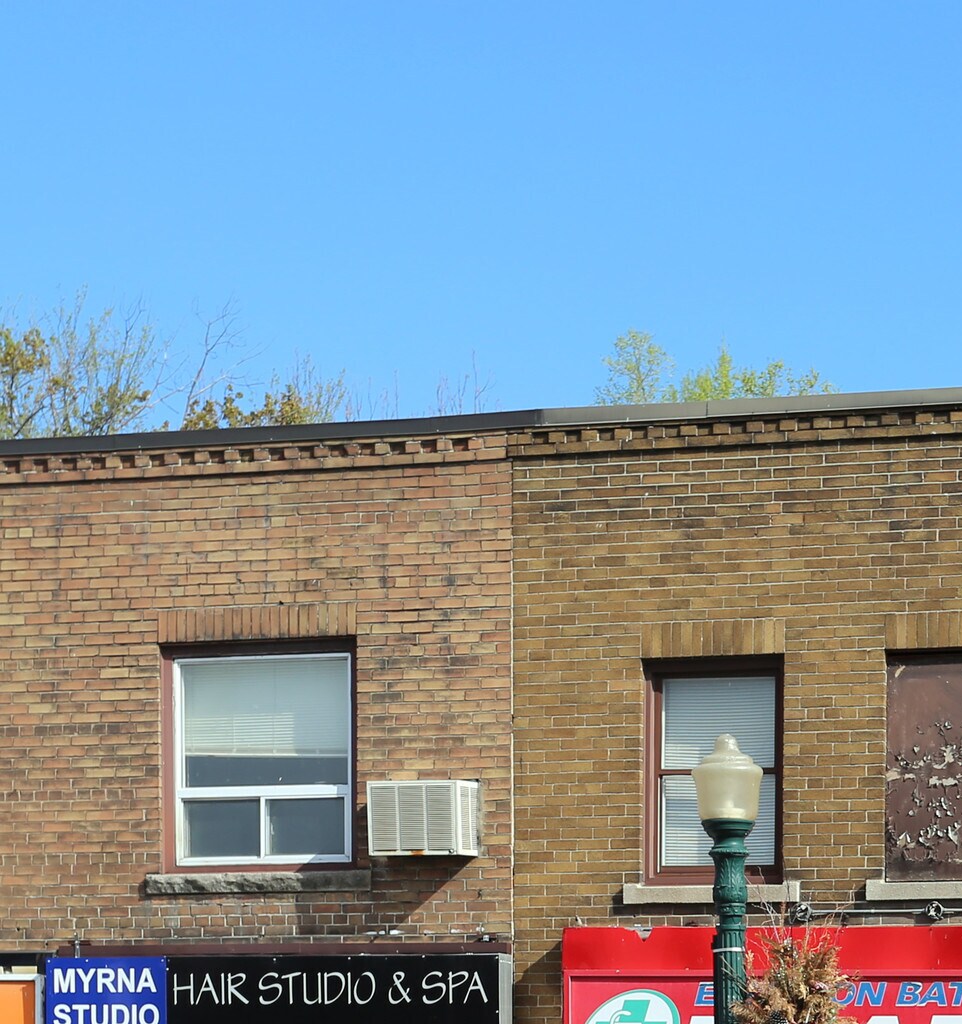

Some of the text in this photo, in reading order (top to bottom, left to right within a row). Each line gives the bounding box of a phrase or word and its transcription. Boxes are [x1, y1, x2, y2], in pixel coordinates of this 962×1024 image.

[53, 968, 157, 994] MYRNA
[173, 970, 489, 1005] HAIR STUDIO & SPA
